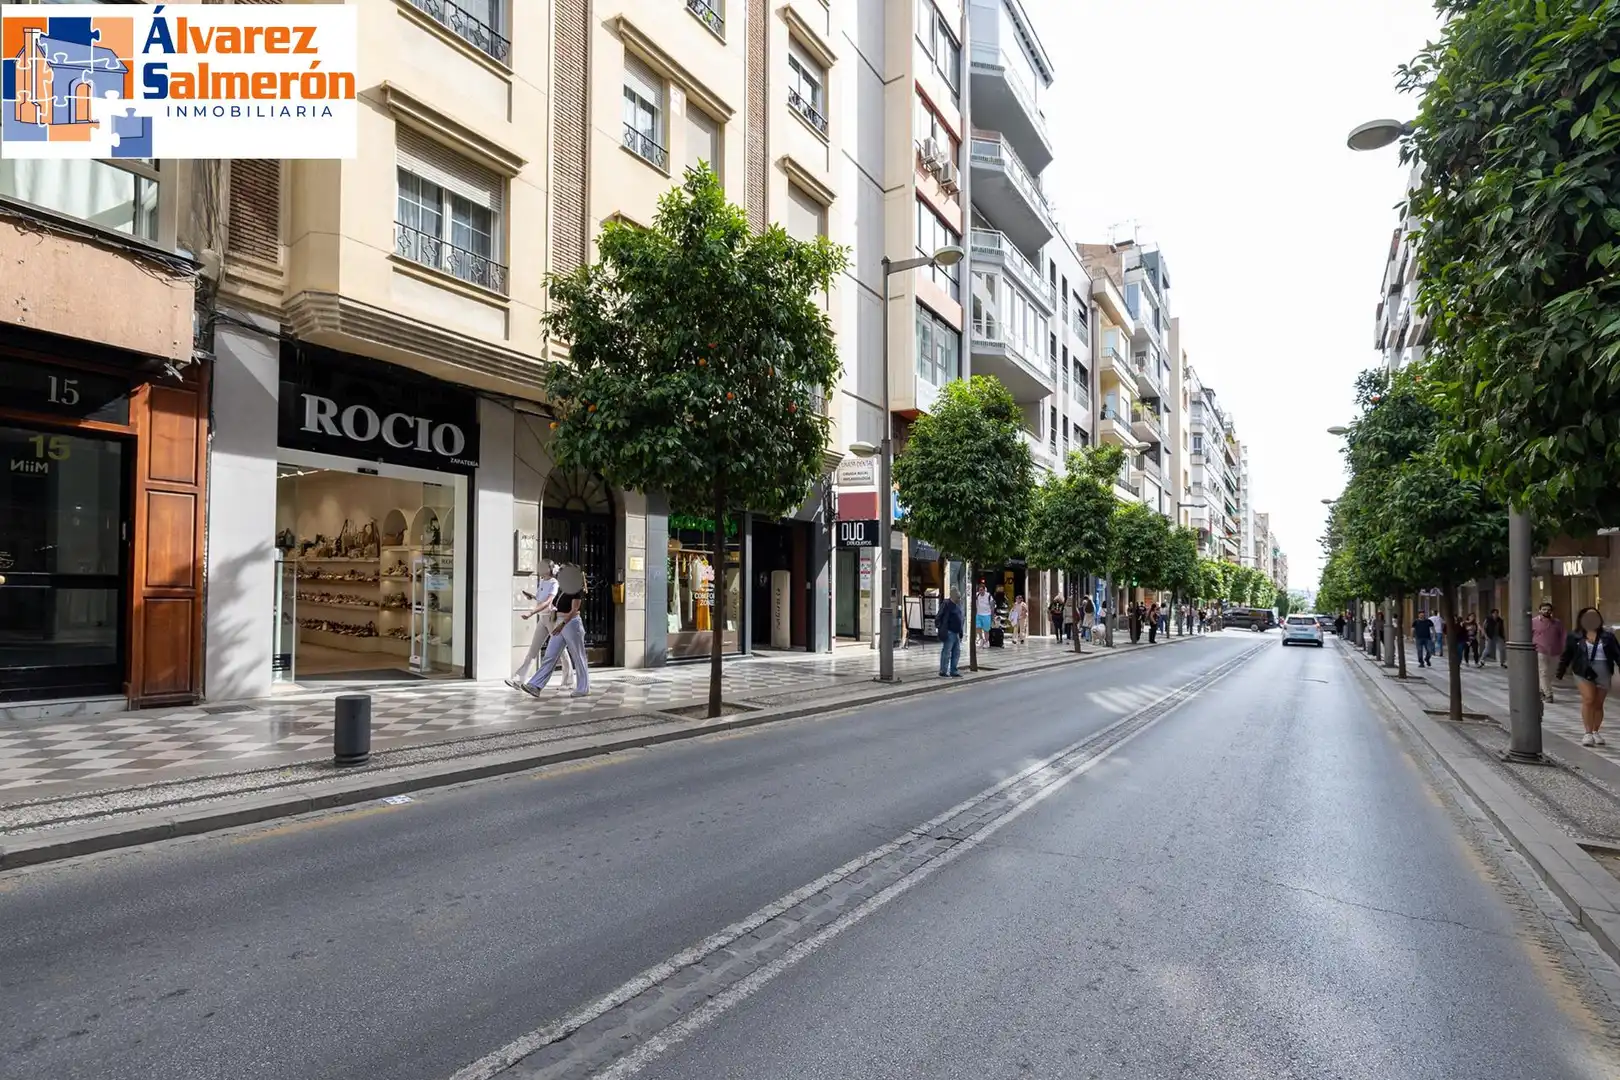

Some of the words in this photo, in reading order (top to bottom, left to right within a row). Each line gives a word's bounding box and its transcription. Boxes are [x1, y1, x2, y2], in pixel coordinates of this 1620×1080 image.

[47, 375, 80, 405] 15
[300, 393, 465, 456] ROCIO
[28, 434, 72, 460] 15
[841, 522, 865, 541] DUO
